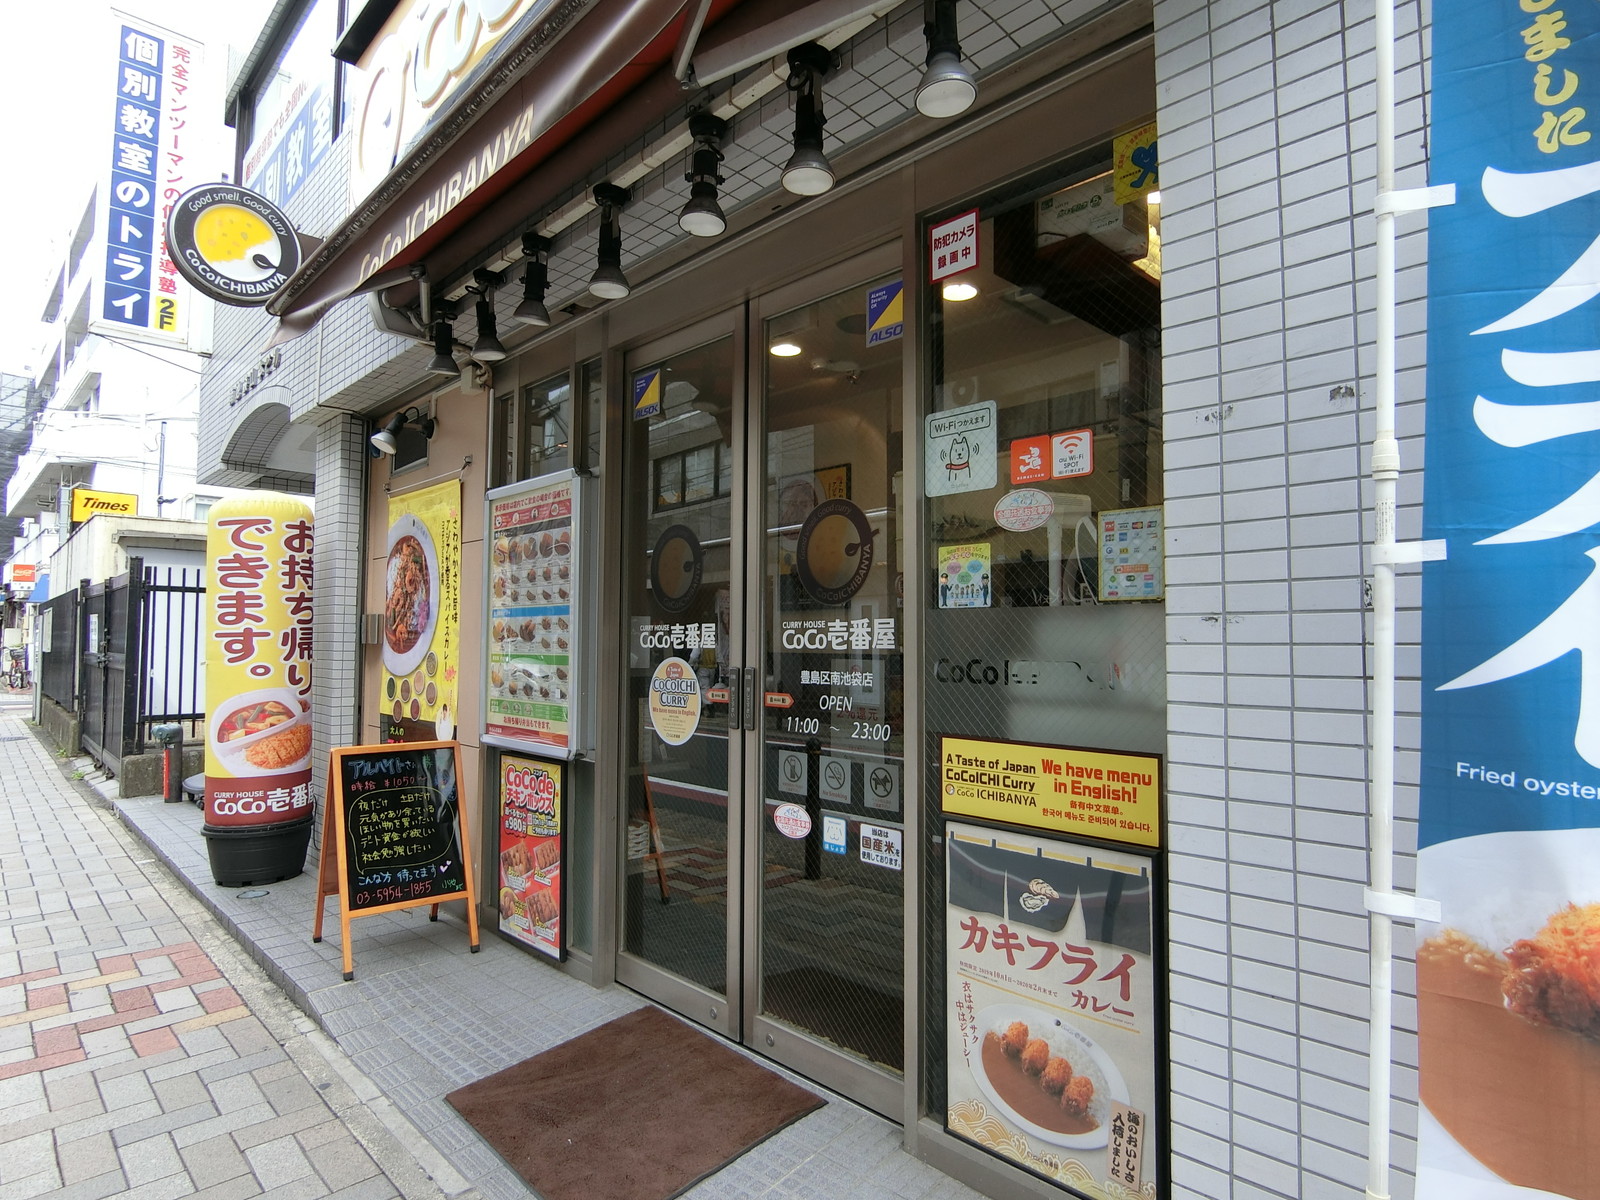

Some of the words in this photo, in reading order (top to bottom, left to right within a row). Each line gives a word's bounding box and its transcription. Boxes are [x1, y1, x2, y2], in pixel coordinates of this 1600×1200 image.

[111, 31, 159, 318] 個別教室のトライ
[188, 192, 213, 212] Good
[214, 191, 242, 202] smell.
[243, 196, 271, 215] Good
[268, 214, 288, 237] curry
[933, 223, 976, 251] 防犯カメラ
[937, 246, 971, 270] 録画中
[185, 249, 288, 294] CoCoICHIBANYA
[159, 298, 175, 330] 2F
[869, 323, 903, 344] ALSO
[635, 403, 658, 418] ALSOK
[1063, 461, 1079, 469] SPOT
[81, 497, 130, 513] Times
[214, 517, 273, 677] できます。
[281, 519, 315, 696] お持ち帰り
[640, 624, 654, 632] CURRY
[803, 620, 826, 628] HOUSE
[652, 678, 697, 693] CoCoICHI
[800, 670, 873, 687] 豊島区南池袋店
[819, 695, 853, 711] OPEN
[390, 725, 405, 736] 大人の
[787, 716, 819, 734] 11:00
[851, 722, 891, 741] 23:00
[946, 753, 953, 764] A
[955, 754, 985, 768] Taste
[988, 758, 999, 769] of
[1002, 760, 1036, 774] Japan
[1041, 758, 1062, 775] We
[1066, 762, 1103, 780] have
[1107, 769, 1152, 786] menu
[1456, 761, 1516, 788] Fried
[506, 765, 536, 792] CoCo
[538, 772, 553, 796] de
[946, 768, 999, 786] CoCoICHI
[1003, 775, 1036, 792] Curry
[1054, 778, 1067, 794] in
[1071, 779, 1137, 804] English!
[236, 790, 264, 798] HOUSE
[358, 798, 388, 811] 夜だけ
[400, 792, 431, 803] 土日だけ
[506, 787, 554, 815] チキンボックス
[956, 788, 974, 798] CoCo
[977, 788, 1037, 807] ICHIBANYA
[360, 805, 435, 825] 元気があり余っている
[1070, 800, 1124, 815] 备有中文菜单。
[360, 816, 434, 835] ほしい物を買いたい
[1042, 807, 1062, 819] 한국어
[1065, 811, 1085, 822] 메뉴도
[1088, 815, 1117, 827] 준비되어
[1119, 819, 1152, 833] 있습니다.
[360, 828, 435, 848] デート資金が欲しい
[871, 827, 889, 838] 当店は
[362, 844, 431, 863] 社会勉強したい
[862, 836, 900, 857] 国産米を
[862, 851, 901, 867] 使用しております。
[358, 871, 392, 885] こんな方
[397, 864, 437, 882] 待ってます
[357, 880, 433, 905] 03-5954-1855
[959, 915, 1136, 1001] カキフライ
[962, 981, 979, 1044] 衣はサクサク
[1071, 989, 1135, 1018] カレー
[955, 1000, 972, 1068] 中はジューシー
[1111, 1112, 1125, 1178] 入荷しました
[1124, 1110, 1140, 1184] 海のおいしさ
